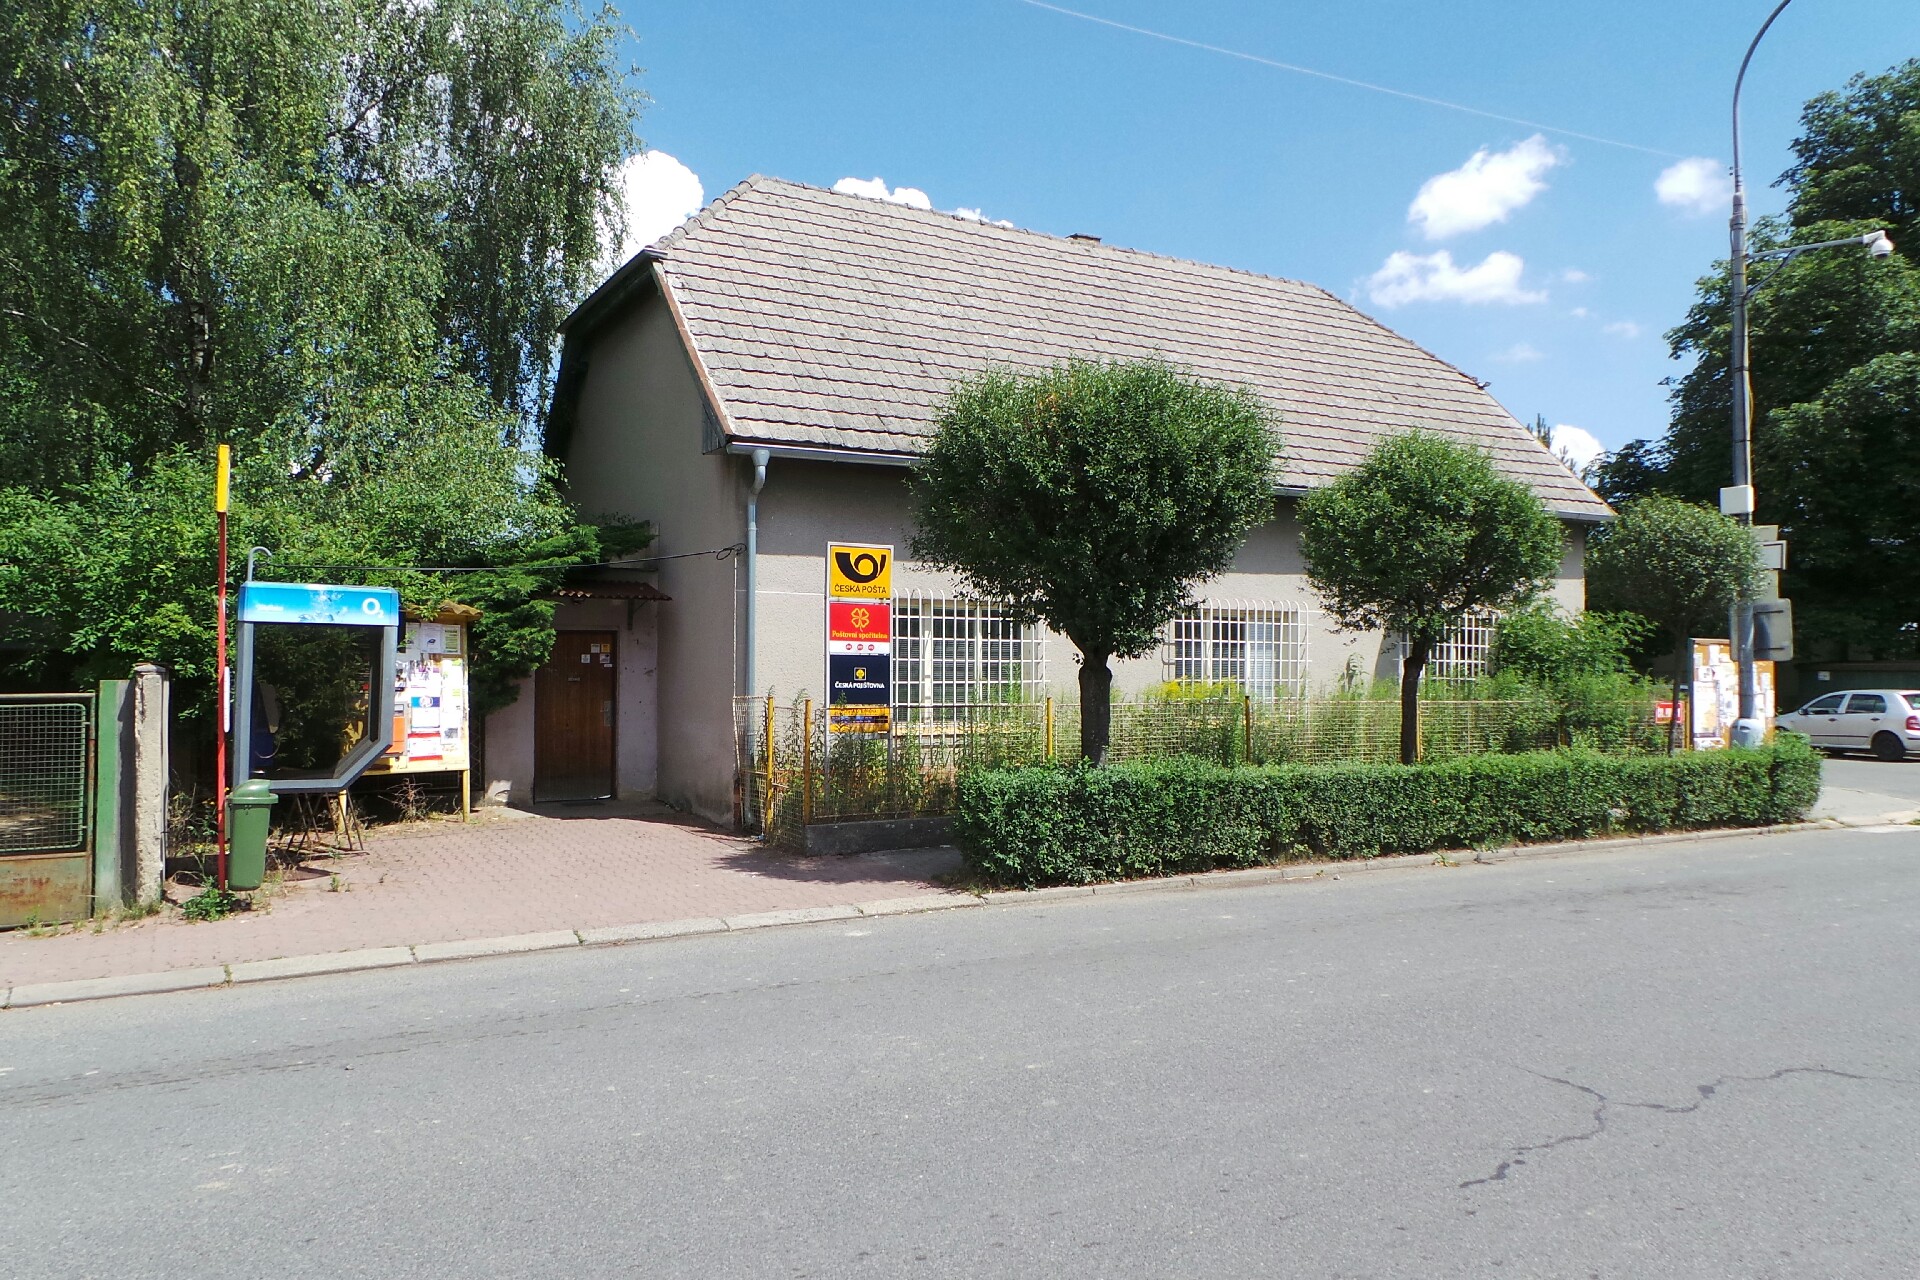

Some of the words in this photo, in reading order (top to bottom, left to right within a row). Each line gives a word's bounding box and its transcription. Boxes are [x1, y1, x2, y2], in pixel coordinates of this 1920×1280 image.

[834, 583, 860, 593] ČESKÁ
[862, 584, 886, 594] POŠTA
[832, 630, 857, 638] Poštovní
[858, 631, 888, 640] spořitelna
[834, 680, 853, 689] ČESKÁ
